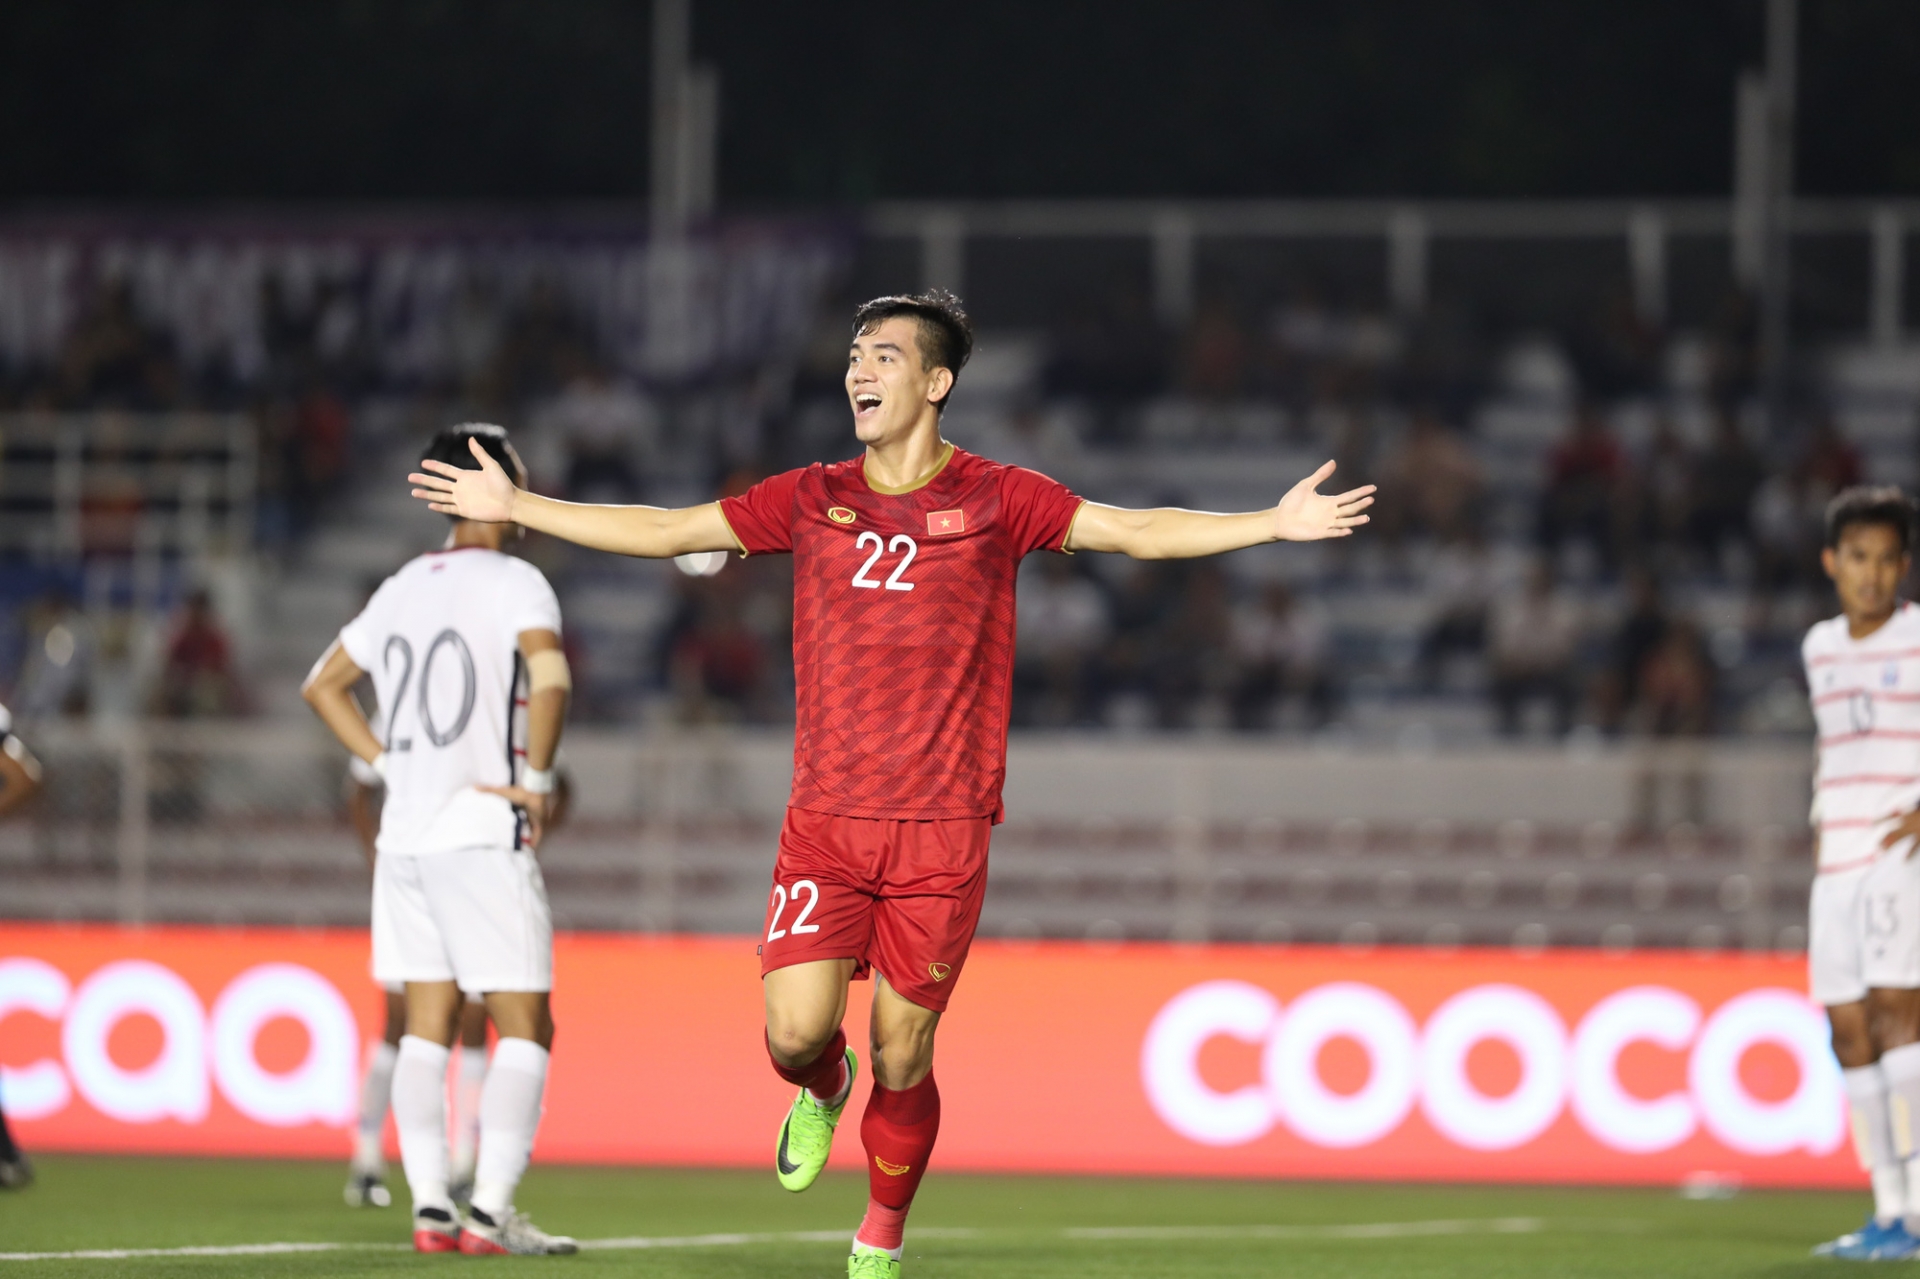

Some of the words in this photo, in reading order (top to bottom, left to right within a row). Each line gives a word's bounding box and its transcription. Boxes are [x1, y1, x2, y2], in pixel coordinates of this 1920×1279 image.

[852, 531, 918, 591] 22
[384, 628, 477, 753] 20
[767, 879, 820, 943] 22
